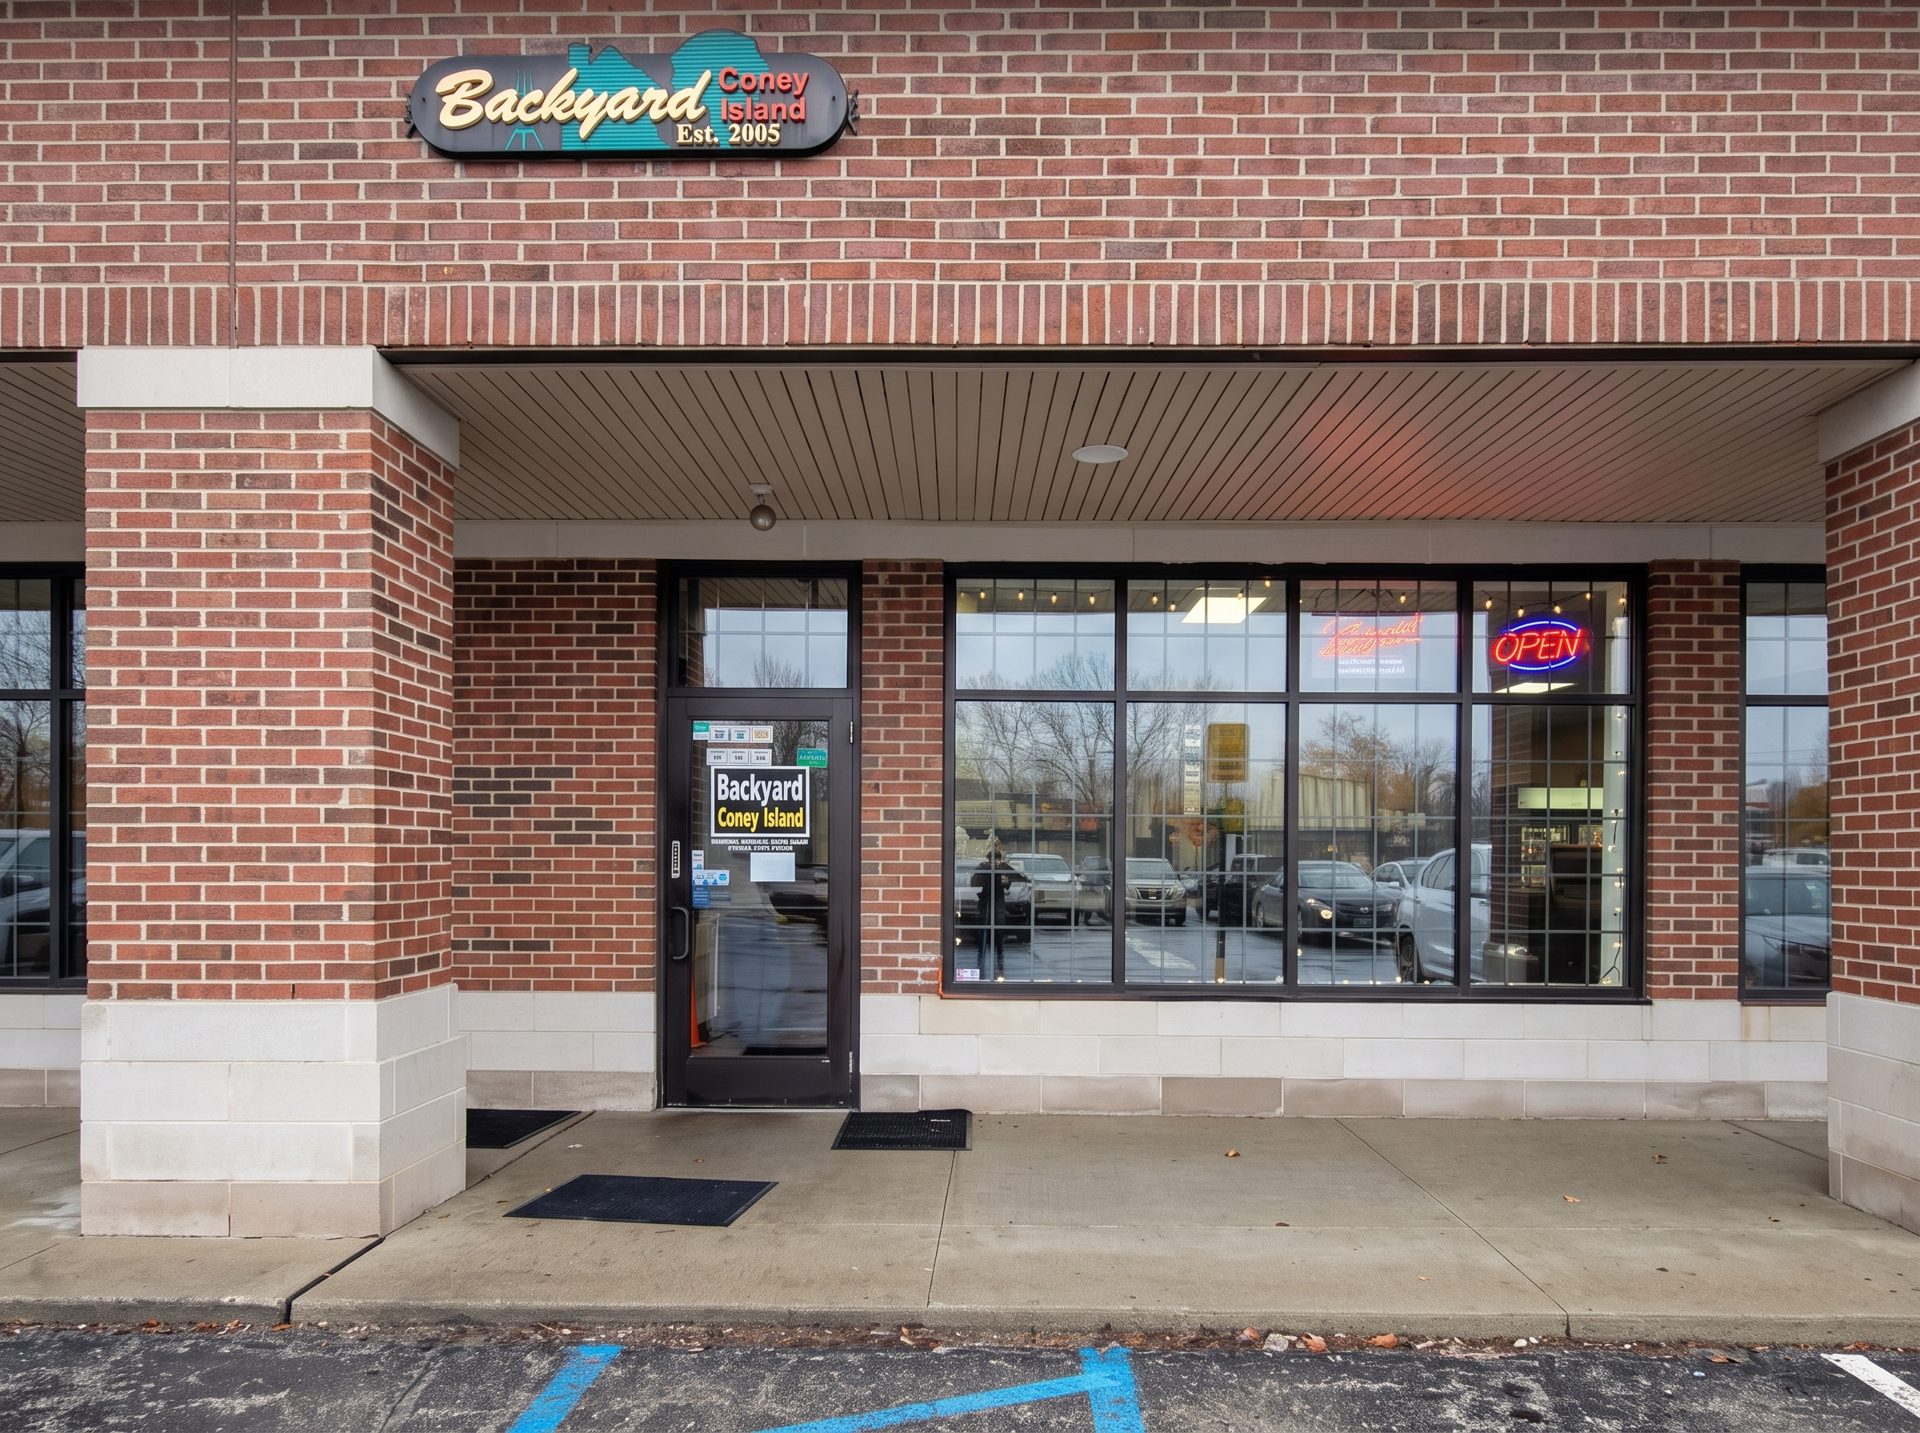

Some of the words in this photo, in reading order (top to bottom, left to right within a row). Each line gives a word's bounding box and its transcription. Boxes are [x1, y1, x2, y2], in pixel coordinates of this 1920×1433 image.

[718, 67, 809, 95] Coney
[435, 67, 711, 141] Backyard
[720, 97, 806, 123] Island
[676, 123, 719, 145] Est.
[728, 123, 781, 145] 2005
[1494, 628, 1582, 663] OPEN
[717, 773, 803, 807] Backyard
[717, 806, 760, 833] Coney
[763, 806, 804, 828] Island
